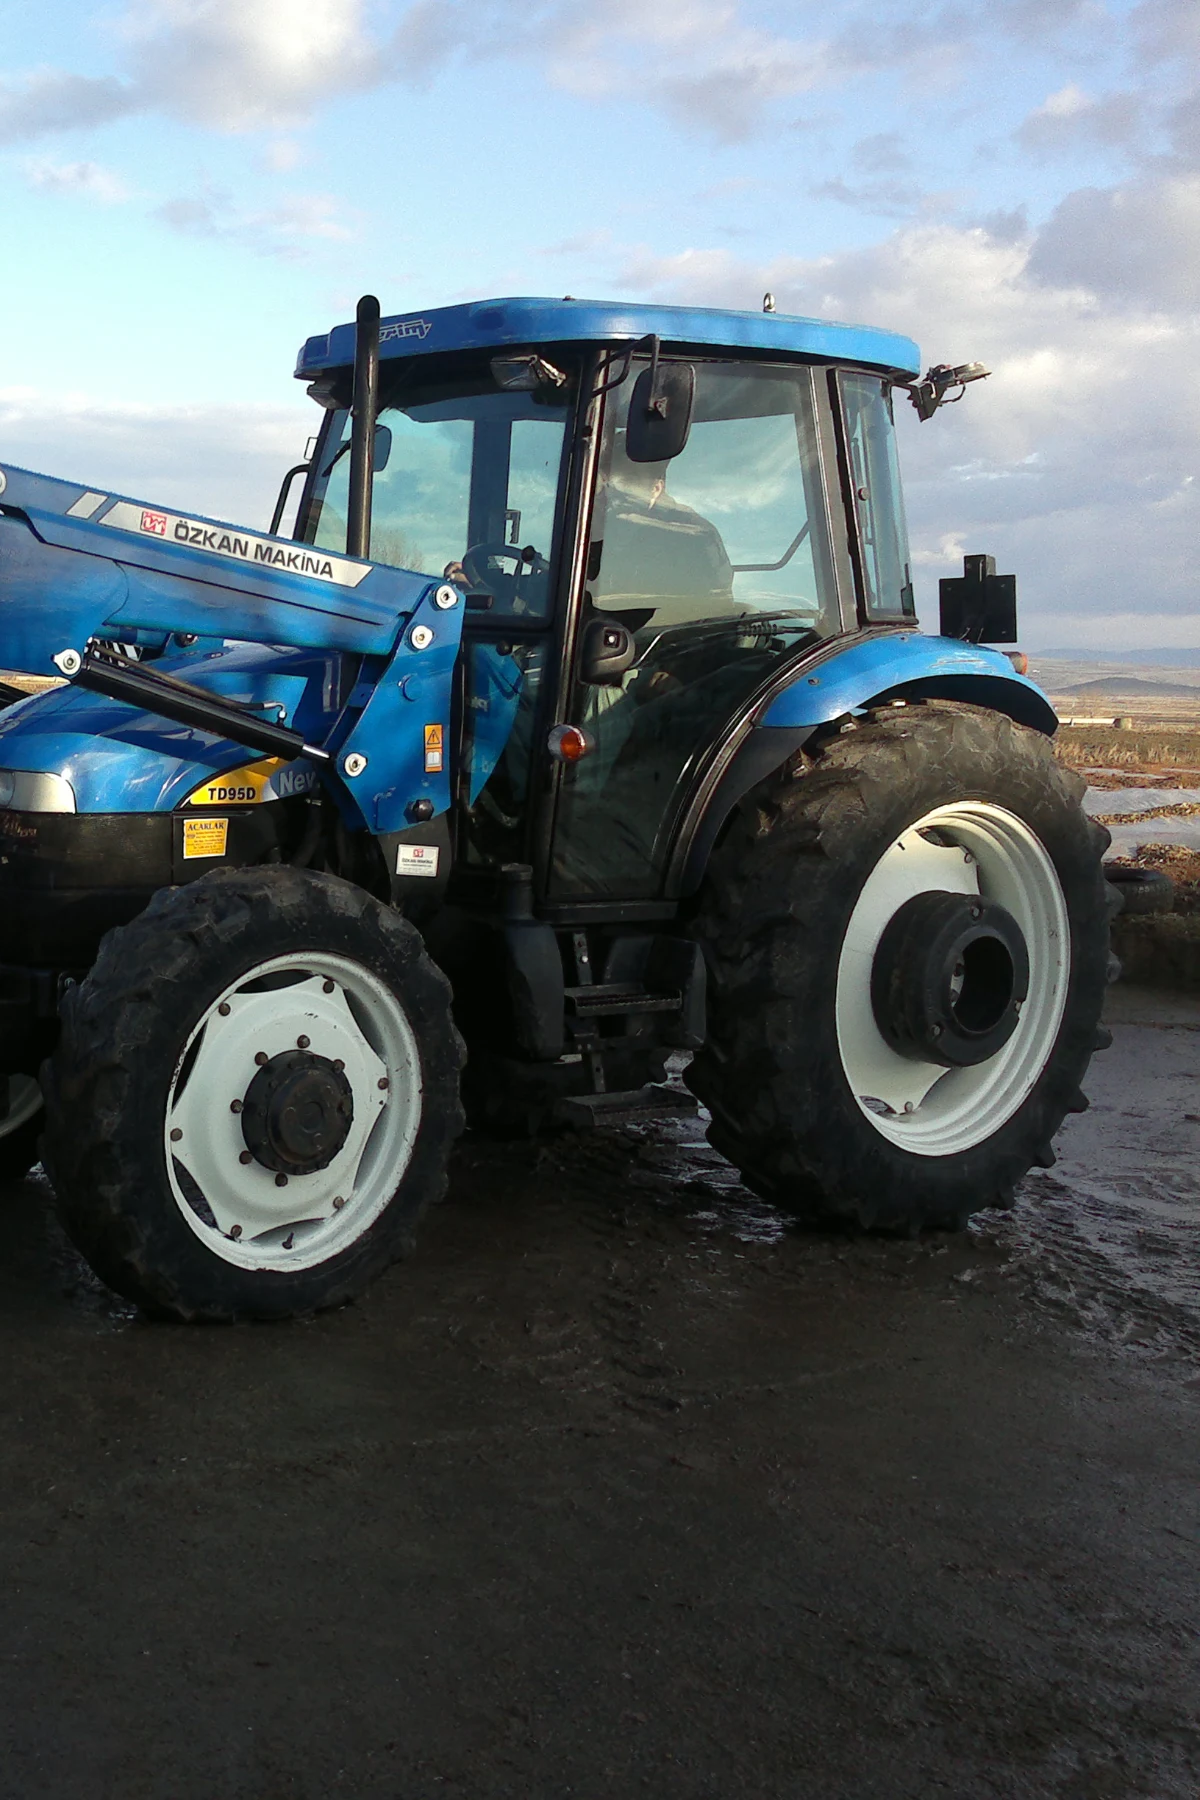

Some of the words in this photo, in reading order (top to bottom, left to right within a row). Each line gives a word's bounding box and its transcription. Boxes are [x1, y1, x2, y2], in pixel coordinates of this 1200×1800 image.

[174, 520, 248, 557] ÖZKAN
[253, 546, 334, 579] MAKİNA
[208, 787, 256, 801] TD95D
